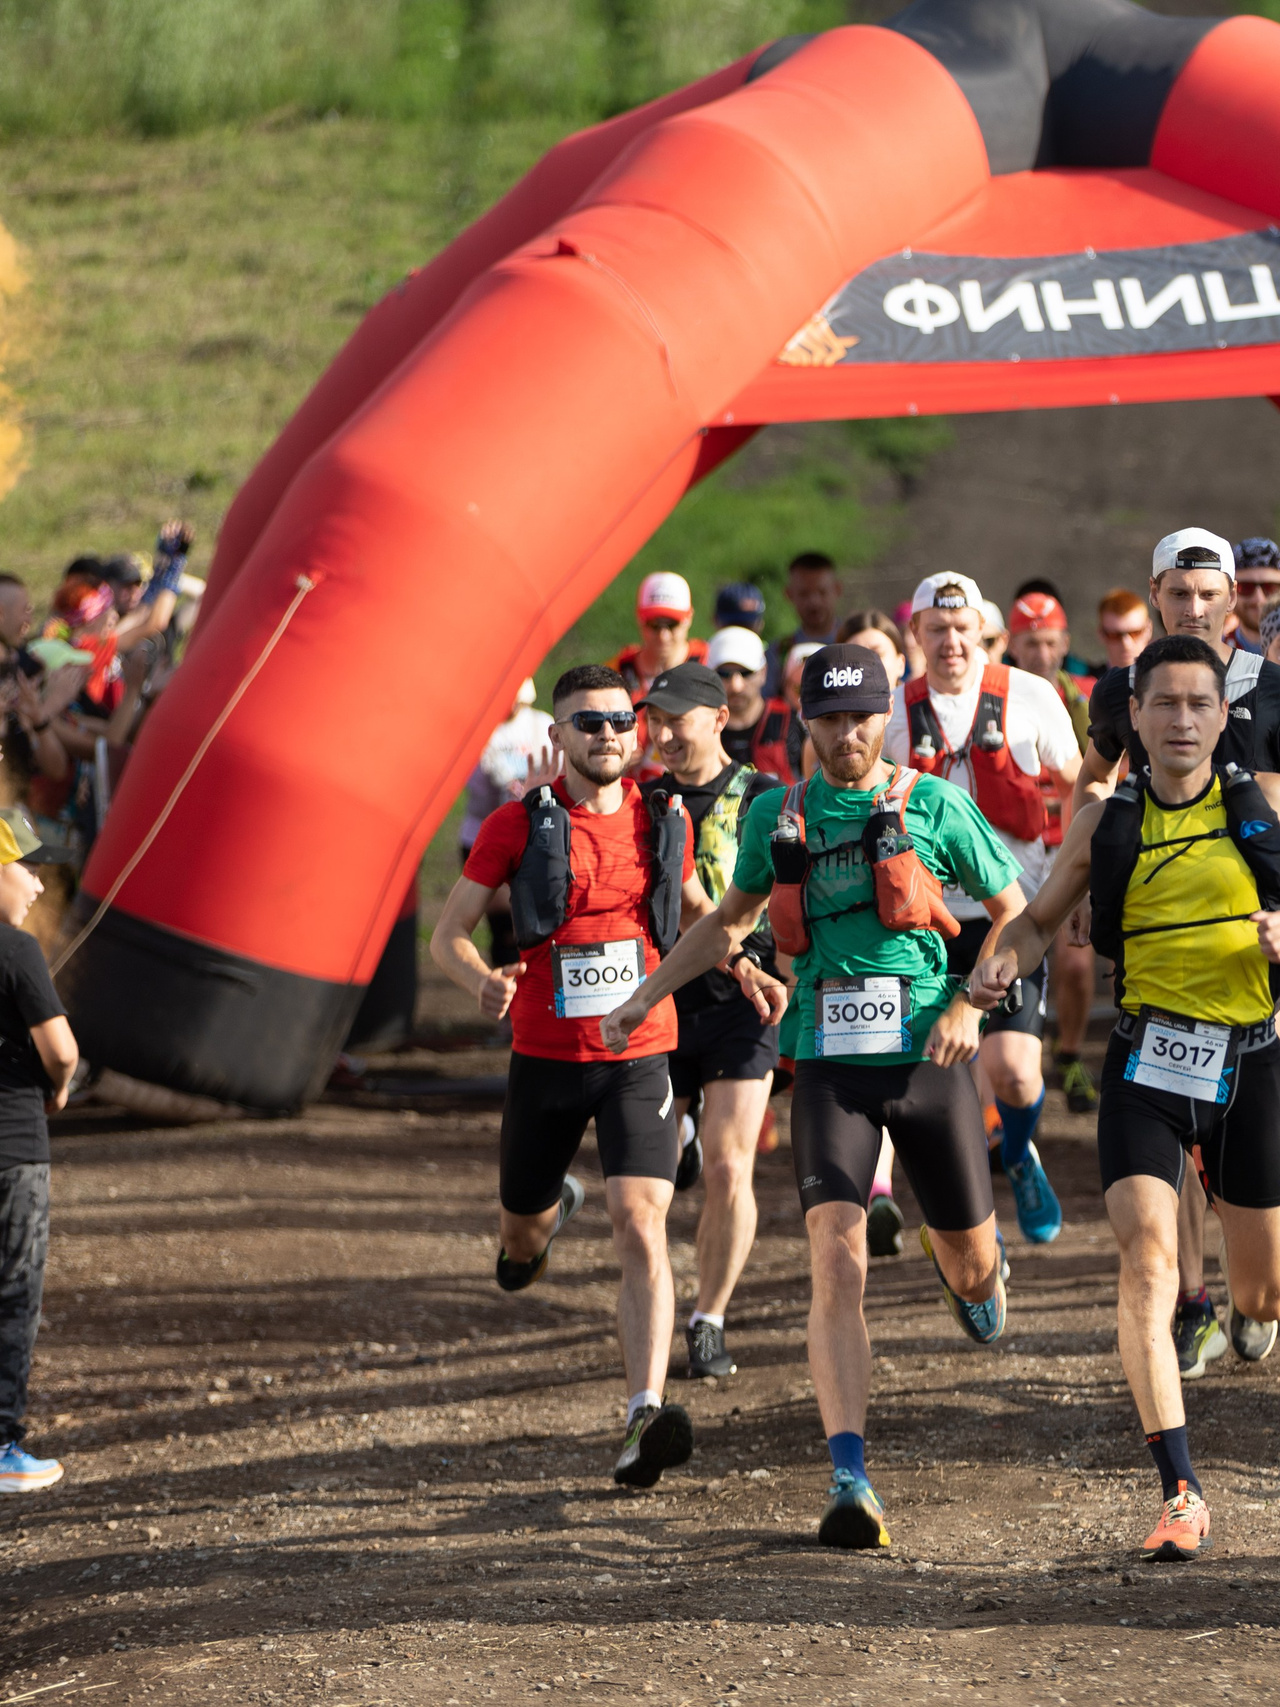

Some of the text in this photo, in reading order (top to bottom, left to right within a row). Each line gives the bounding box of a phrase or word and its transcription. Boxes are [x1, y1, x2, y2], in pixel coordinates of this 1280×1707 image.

[568, 964, 634, 988] 3006
[827, 1001, 896, 1024] 3009
[1149, 1025, 1178, 1038] ВОЗДУХ
[1152, 1036, 1216, 1068] 3017
[1204, 1039, 1214, 1047] 46
[1168, 1061, 1192, 1073] СЕРГЕЙ
